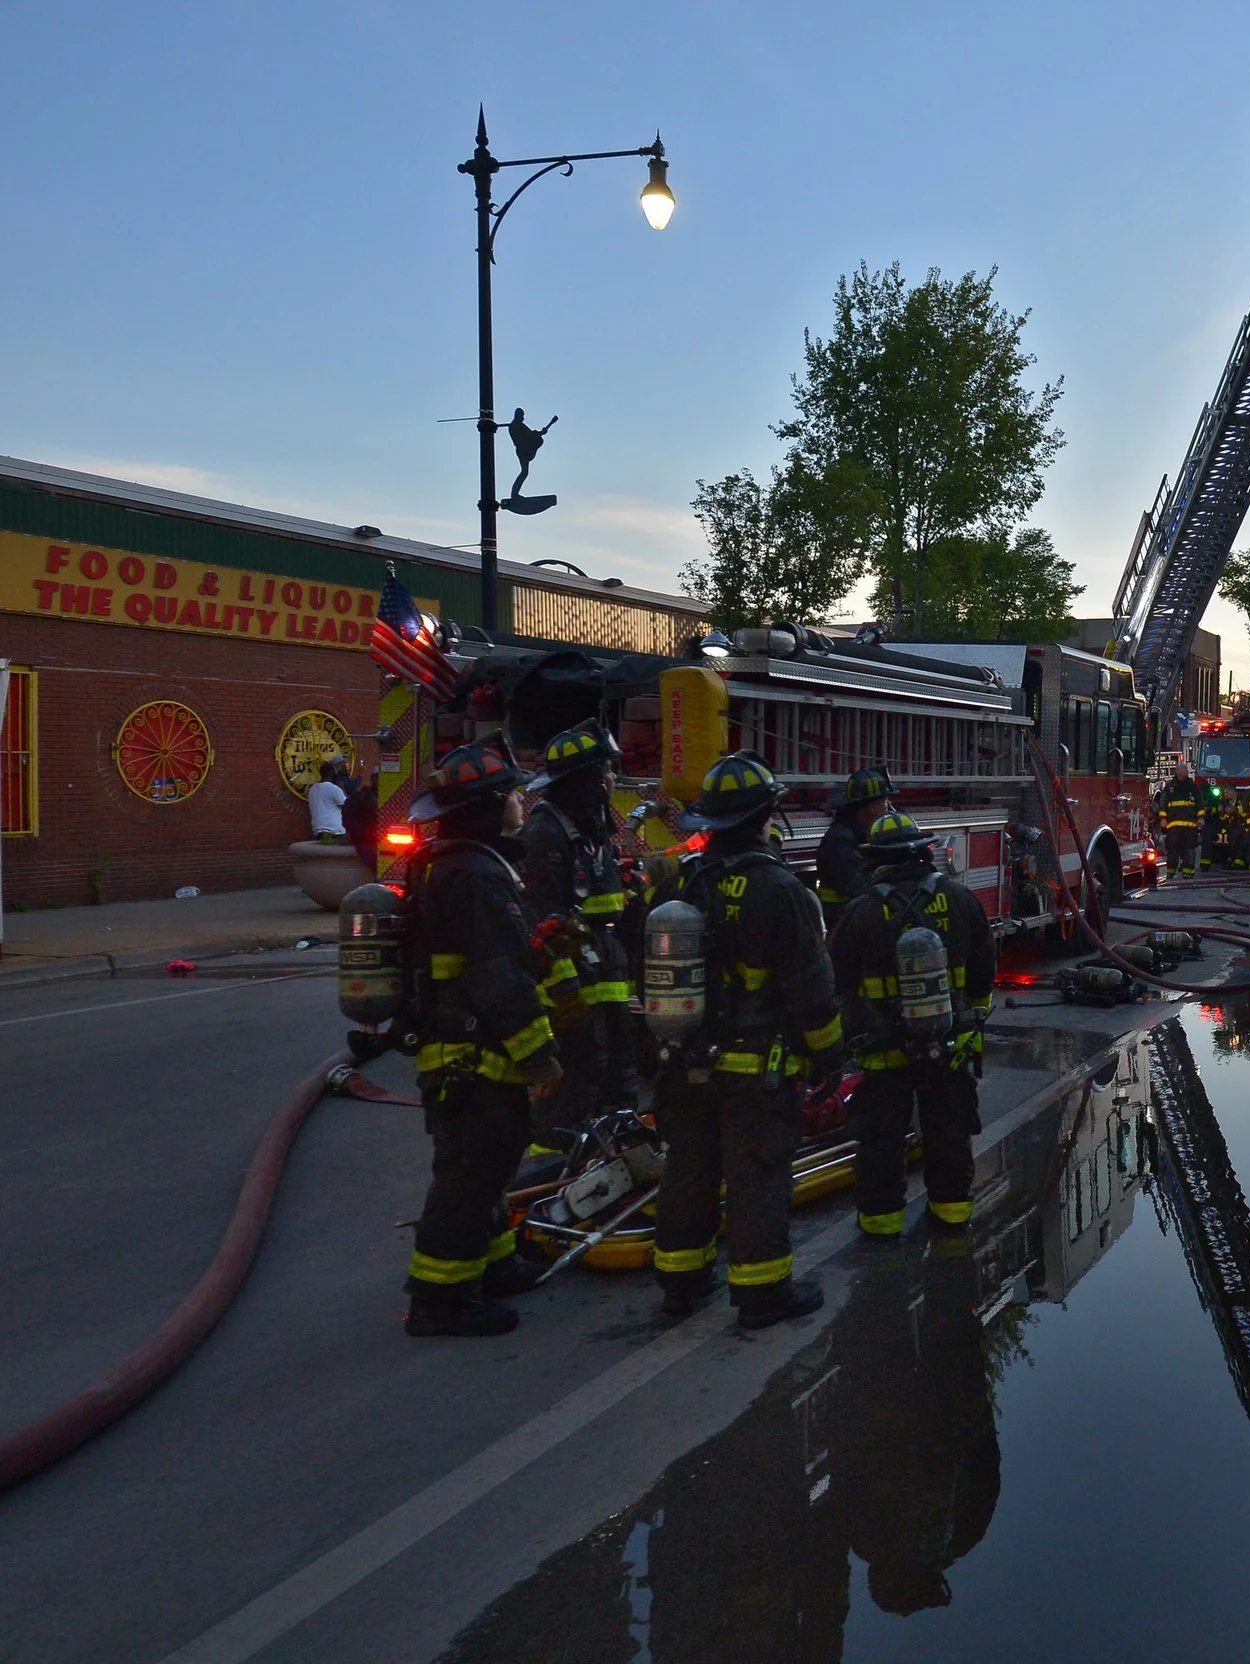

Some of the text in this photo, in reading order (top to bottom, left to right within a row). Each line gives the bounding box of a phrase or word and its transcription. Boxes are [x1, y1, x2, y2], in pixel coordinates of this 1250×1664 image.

[33, 579, 114, 616] THE
[125, 593, 279, 635] QUALITY
[46, 545, 374, 617] FOOD & LIQUOR
[294, 740, 335, 753] Illinois
[672, 690, 682, 774] KEEP BACK
[1206, 777, 1217, 786] 18
